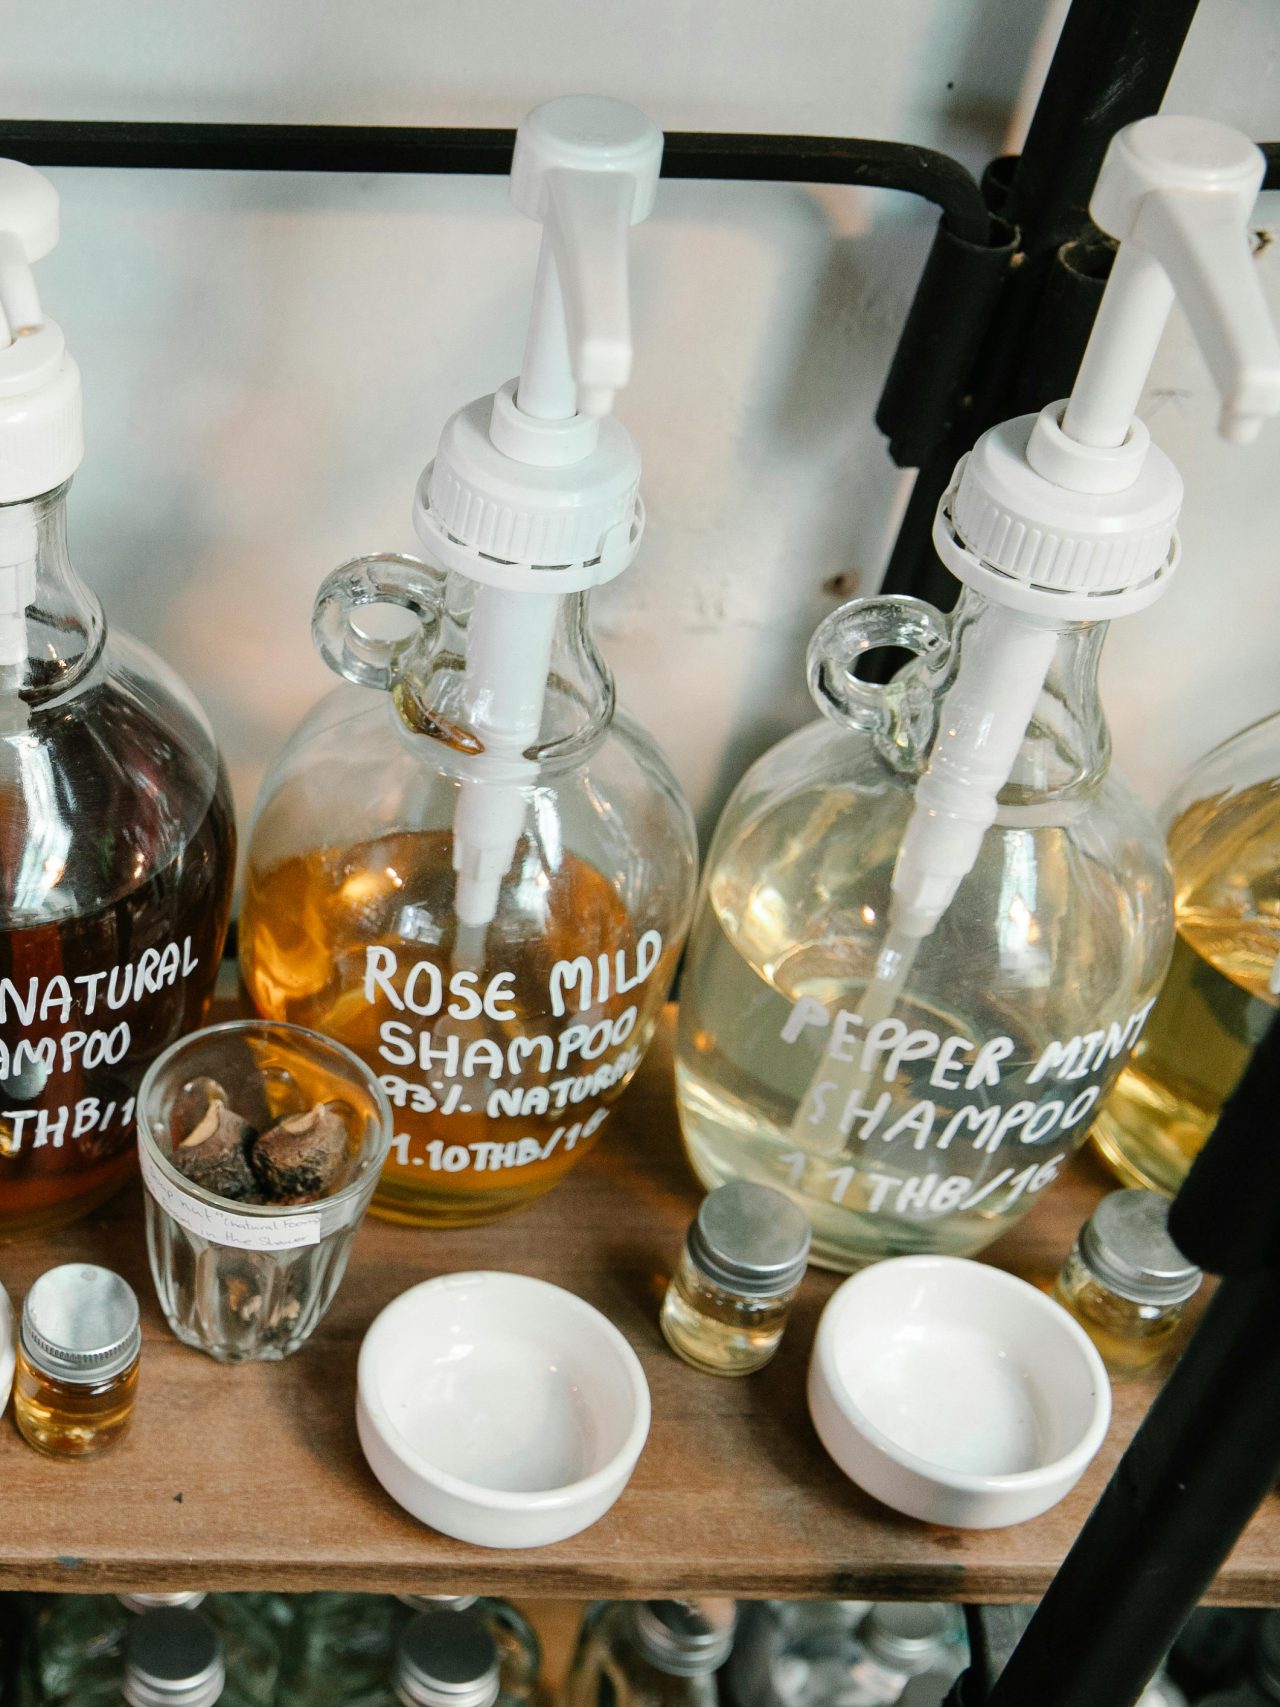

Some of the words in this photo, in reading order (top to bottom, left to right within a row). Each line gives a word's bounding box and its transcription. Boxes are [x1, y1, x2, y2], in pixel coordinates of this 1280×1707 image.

[364, 945, 517, 1022] ROSE
[549, 929, 663, 1018] MILD
[378, 1006, 638, 1080] SHAMPOO
[780, 994, 1015, 1091] PEPPER
[1024, 996, 1157, 1085] MINT
[486, 1045, 642, 1118] NATURAL
[1, 1096, 136, 1153] THB/1
[807, 1085, 1101, 1153] SHAMPOO
